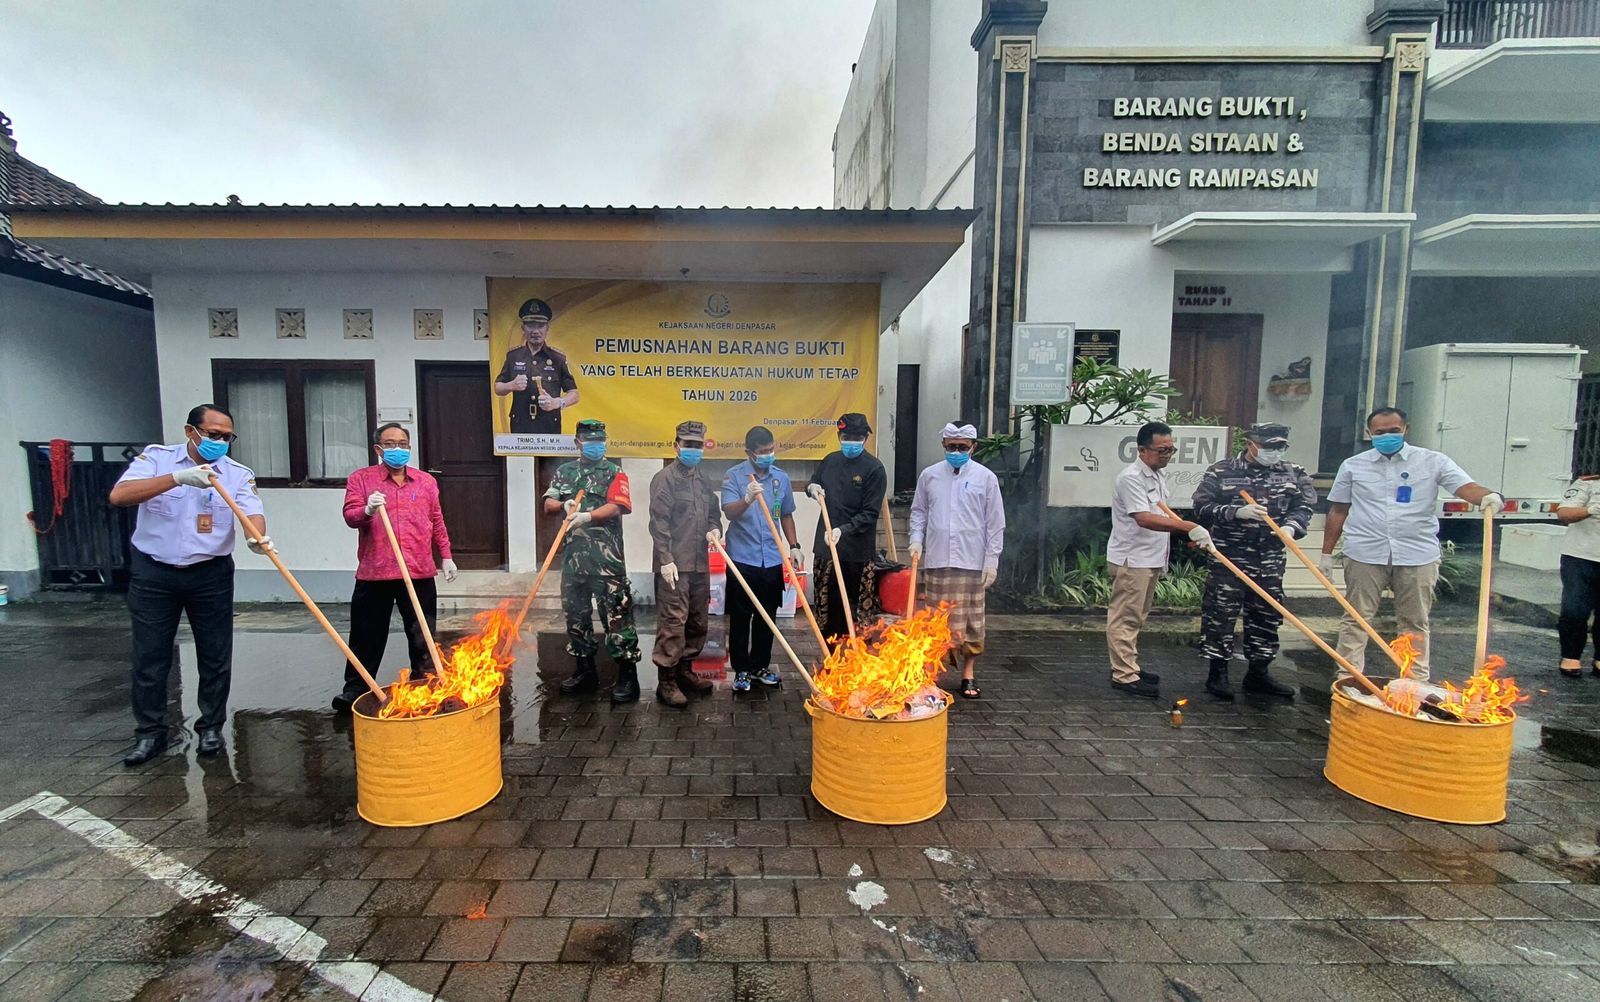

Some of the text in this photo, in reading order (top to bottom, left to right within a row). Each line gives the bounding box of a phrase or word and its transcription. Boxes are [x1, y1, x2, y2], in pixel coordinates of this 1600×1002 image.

[1114, 97, 1212, 117] BARANG
[1220, 97, 1294, 116] BUKTI
[1103, 132, 1304, 152] BENDA SITAAN &
[1083, 168, 1318, 188] BARANG RAMPASAN
[1185, 286, 1226, 295] RUANG
[1178, 297, 1217, 306] TAHAP
[706, 322, 734, 330] NEGERI
[595, 339, 844, 355] PEMUSNAHAN BARANG BUKTI
[581, 365, 859, 379] YANG TELAH BERKEKUATAN HUKUM TETAP
[682, 390, 757, 401] TAHUN 2026
[610, 440, 673, 448] kejari-denpasar.go.id
